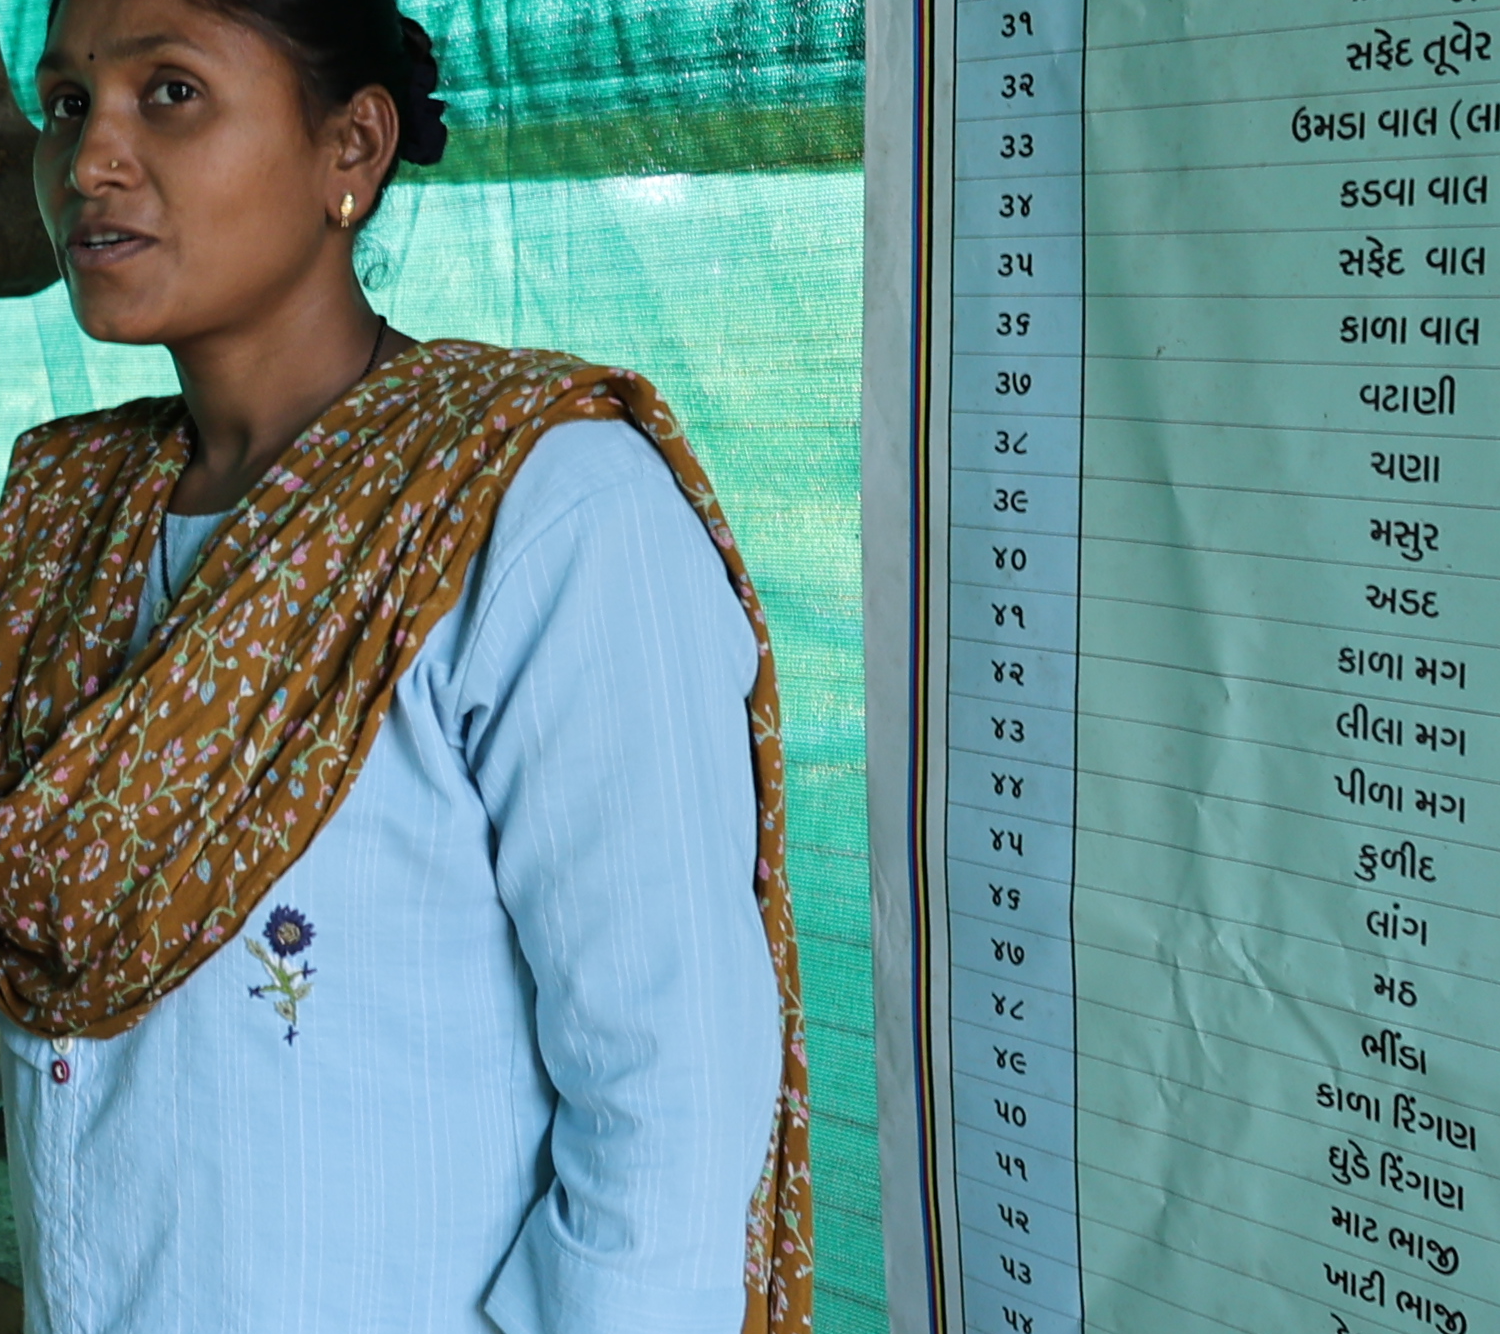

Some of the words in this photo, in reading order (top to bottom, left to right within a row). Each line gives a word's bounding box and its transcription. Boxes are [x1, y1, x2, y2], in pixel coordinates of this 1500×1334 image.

[1001, 11, 1033, 38] ૩૧
[1347, 28, 1413, 71] સફેદ
[1423, 20, 1491, 76] તૂવેર
[1292, 106, 1365, 143] ઉમડા
[1378, 107, 1437, 137] વાલ
[1000, 134, 1033, 159] ૩૩
[999, 194, 1032, 218] ૩૪
[1341, 179, 1414, 208] કડવા
[1428, 175, 1487, 205] વાલ
[1340, 236, 1404, 278] સફેદ
[1426, 247, 1485, 275] વાલ
[997, 313, 1030, 336] ૩૬
[1341, 316, 1406, 344] કાળા
[1420, 317, 1479, 345] વાલ
[996, 372, 1031, 395] ૩૭
[1360, 375, 1455, 415] વટાણી
[1371, 452, 1439, 483] ચણા
[994, 489, 1026, 513] ૩૯
[1371, 519, 1438, 562] મસુર
[992, 604, 1024, 628] ૪૧
[1367, 585, 1438, 618] અડદ
[1339, 647, 1403, 680] કાળા
[1416, 657, 1465, 689] મગ
[992, 717, 1024, 742] ૪૩
[1336, 703, 1402, 746] લીલા
[1416, 723, 1465, 756] મગ
[992, 773, 1023, 798] ૪૪
[1335, 768, 1402, 811] પીળા
[1415, 790, 1465, 823] મગ
[1355, 841, 1436, 882] કુળીદ
[989, 884, 1020, 910] ૪૬
[1366, 910, 1427, 945] લાંગ
[992, 939, 1024, 965] ૪૭
[1374, 974, 1417, 1007] મઠ
[994, 1047, 1024, 1074] ૪૯
[1361, 1029, 1427, 1075] ભીંડા
[995, 1099, 1026, 1127] ૫૦
[1317, 1083, 1380, 1122] કાળા
[1393, 1093, 1476, 1151] રિંગણ
[996, 1152, 1026, 1180] ૫૧
[1380, 1151, 1463, 1211] રિંગણ
[1332, 1206, 1378, 1243] માટ
[1388, 1227, 1459, 1276] ભાજી
[1001, 1255, 1031, 1284] ૫૩
[1324, 1263, 1385, 1307] ખાટી
[1003, 1307, 1032, 1334] ૫૪
